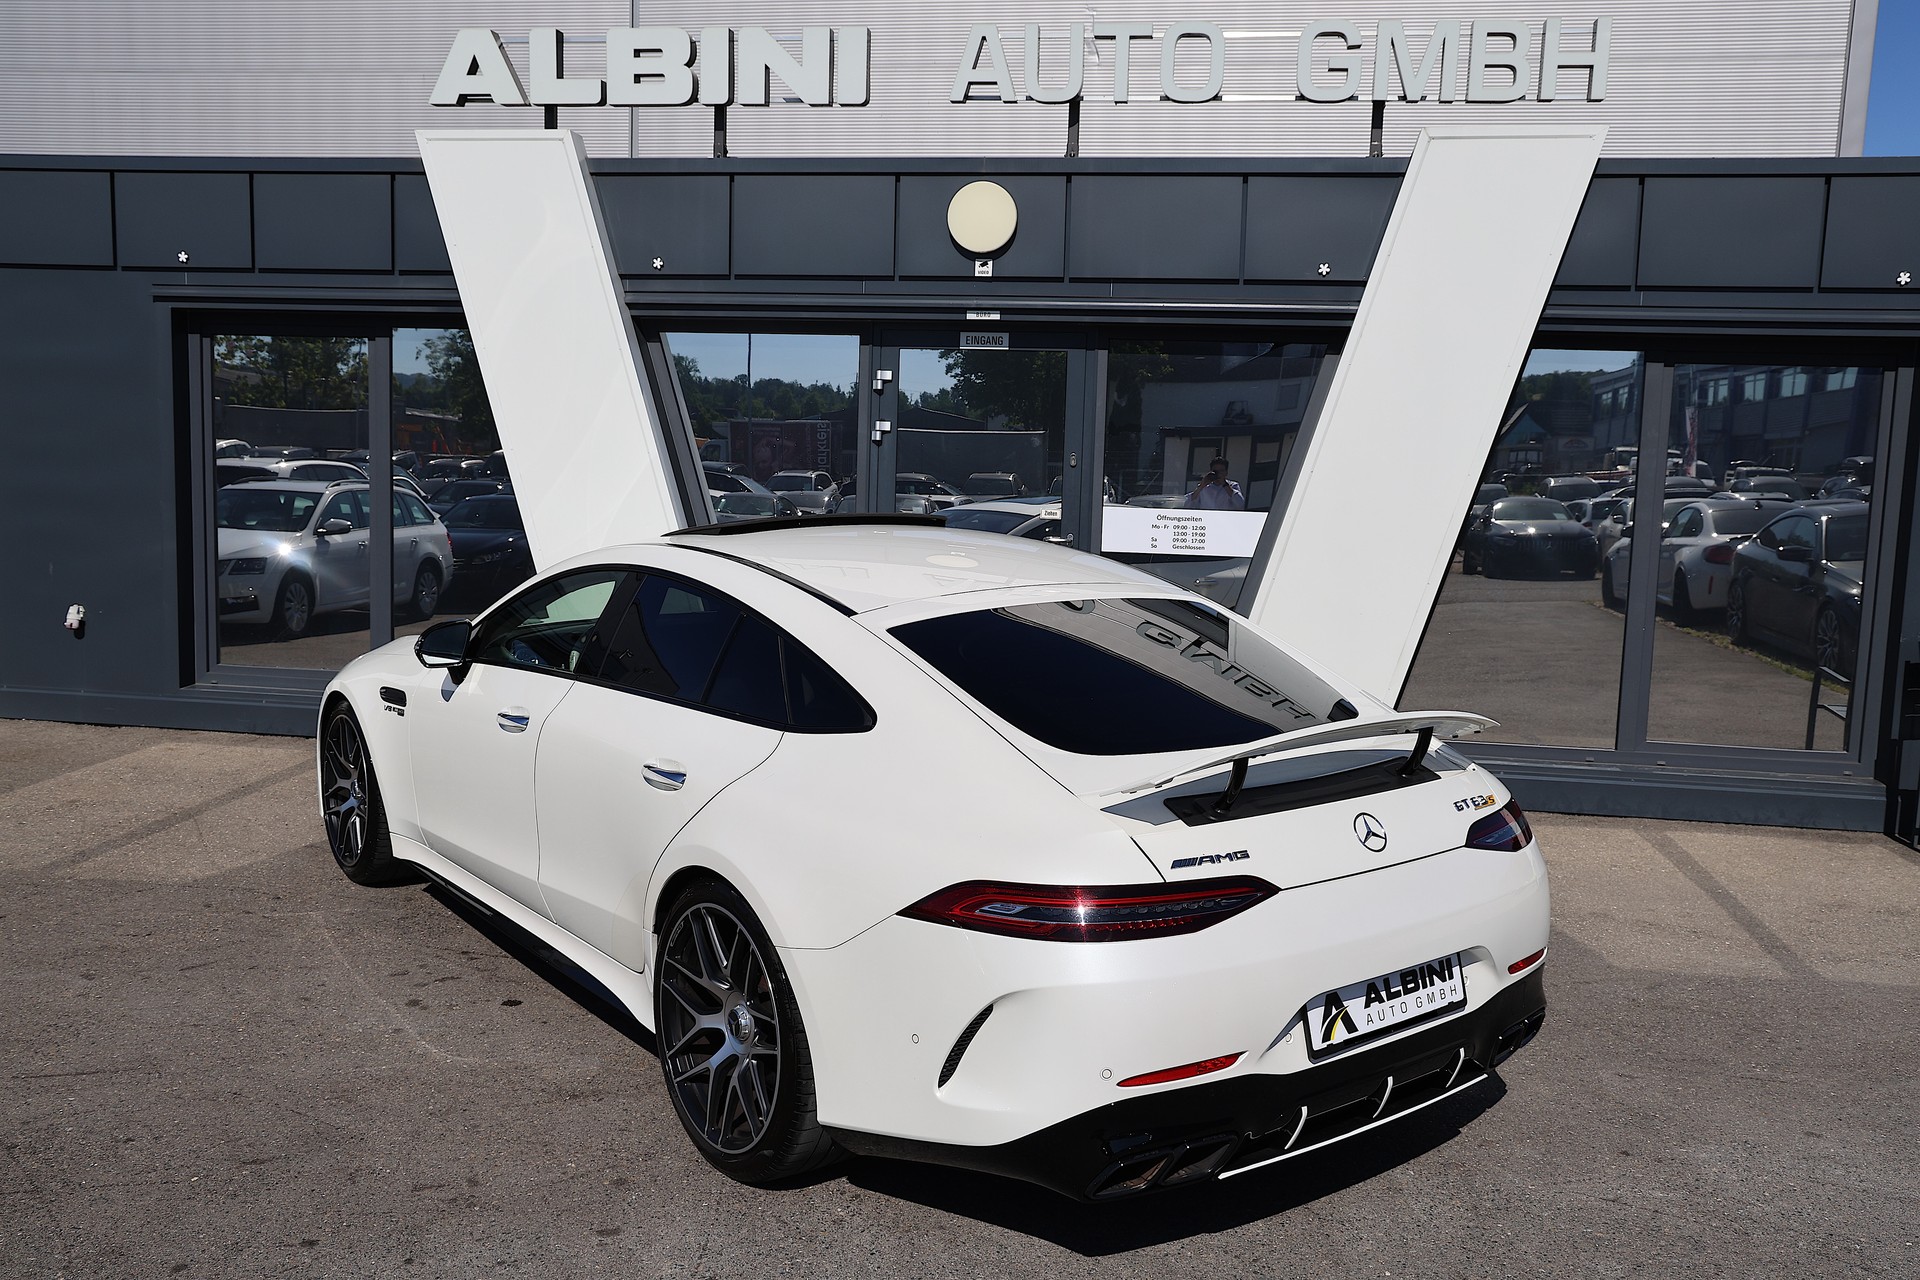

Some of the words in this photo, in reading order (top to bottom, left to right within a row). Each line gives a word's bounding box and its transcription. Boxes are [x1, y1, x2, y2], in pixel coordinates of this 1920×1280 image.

[428, 26, 871, 108] ALBINI
[949, 20, 1227, 104] AUTO
[1296, 15, 1613, 104] GMBH
[965, 335, 1004, 346] EINGANG
[1156, 513, 1203, 523] Öffnungszeiten
[1197, 849, 1250, 867] AMG
[1363, 957, 1455, 1010] ALBINI
[1366, 1001, 1408, 1026] AUTO
[1415, 984, 1458, 1009] GMBH
